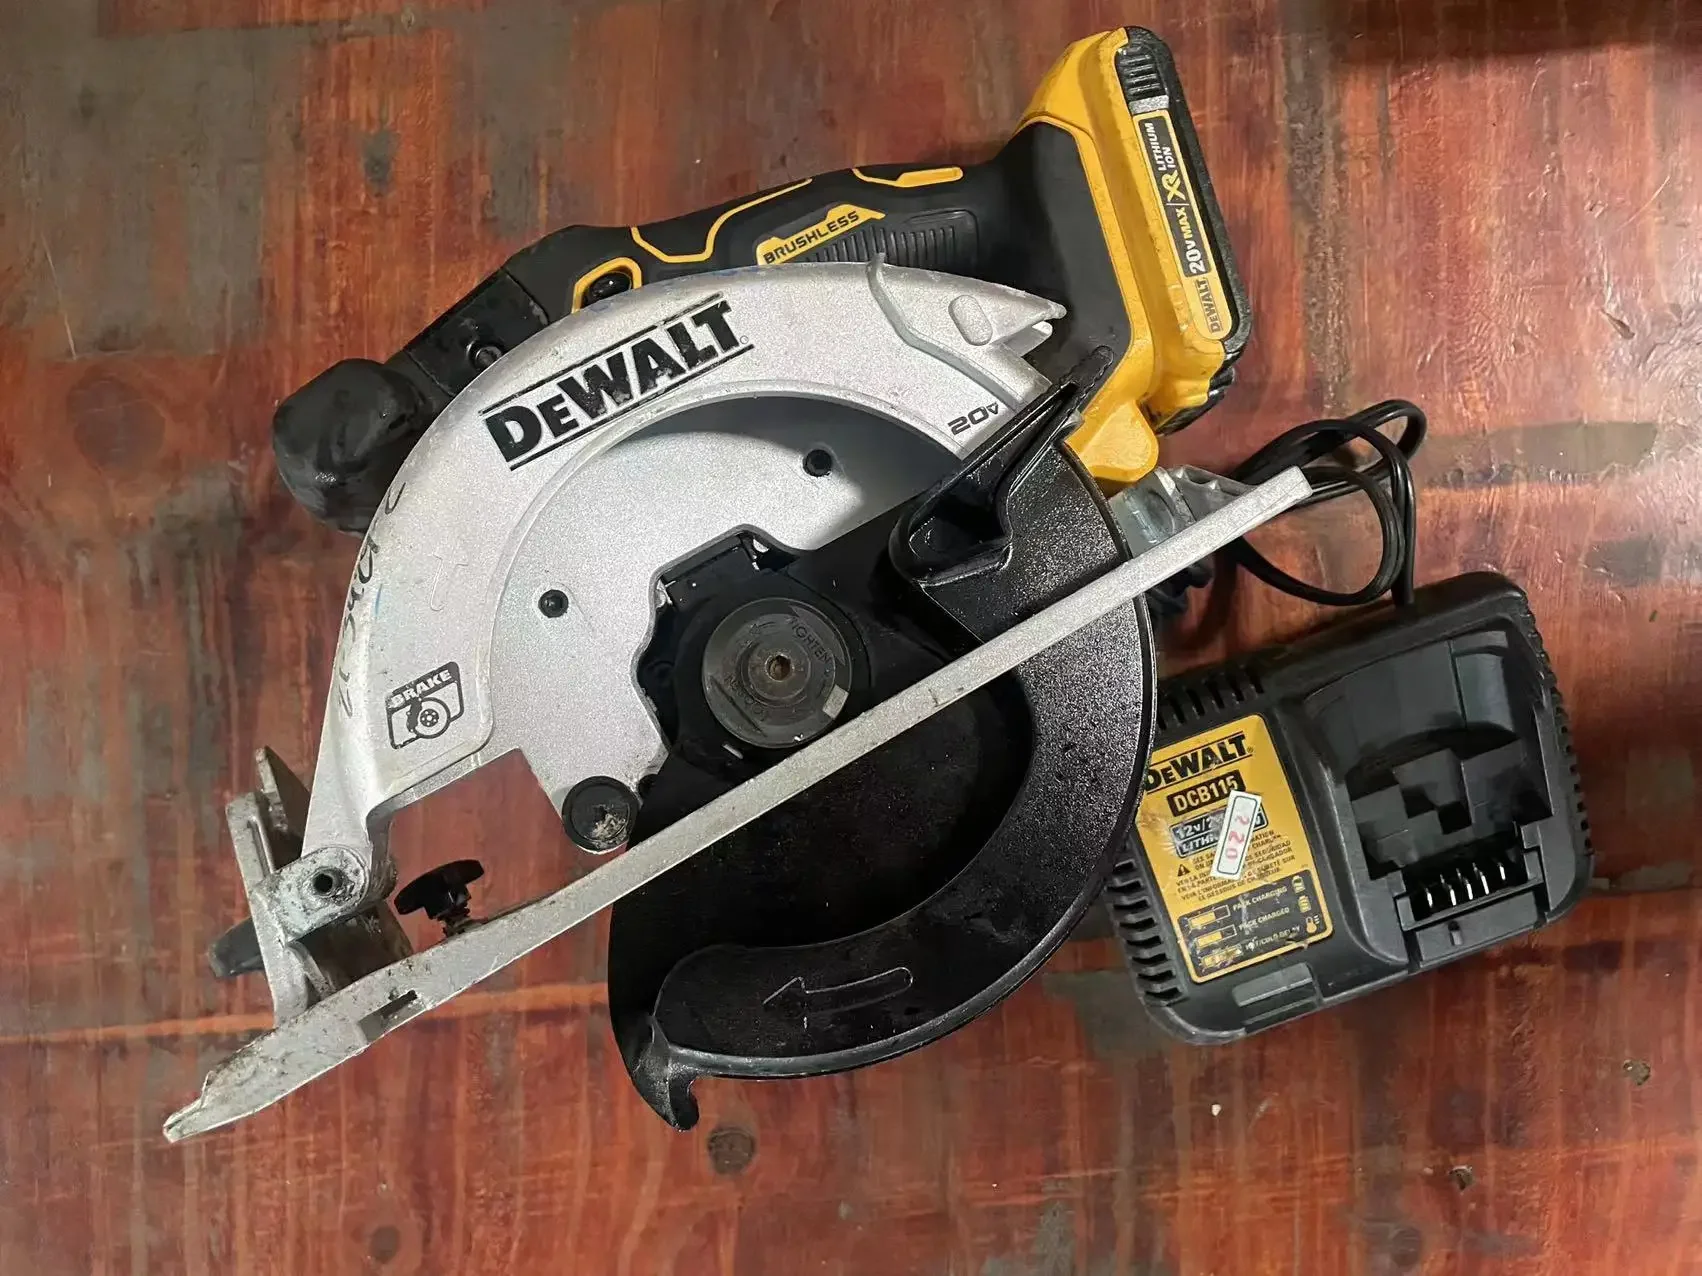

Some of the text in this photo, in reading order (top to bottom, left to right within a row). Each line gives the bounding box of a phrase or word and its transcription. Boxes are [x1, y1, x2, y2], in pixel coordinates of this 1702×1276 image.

[1144, 122, 1166, 171] LITHIUM
[1161, 146, 1176, 168] ION
[1161, 170, 1186, 203] XR
[763, 211, 859, 264] BRUSHLESS
[1197, 280, 1221, 333] DEWALT
[485, 300, 740, 462] DEWALT
[387, 669, 452, 709] BRAKE
[1173, 775, 1238, 812] DCB115
